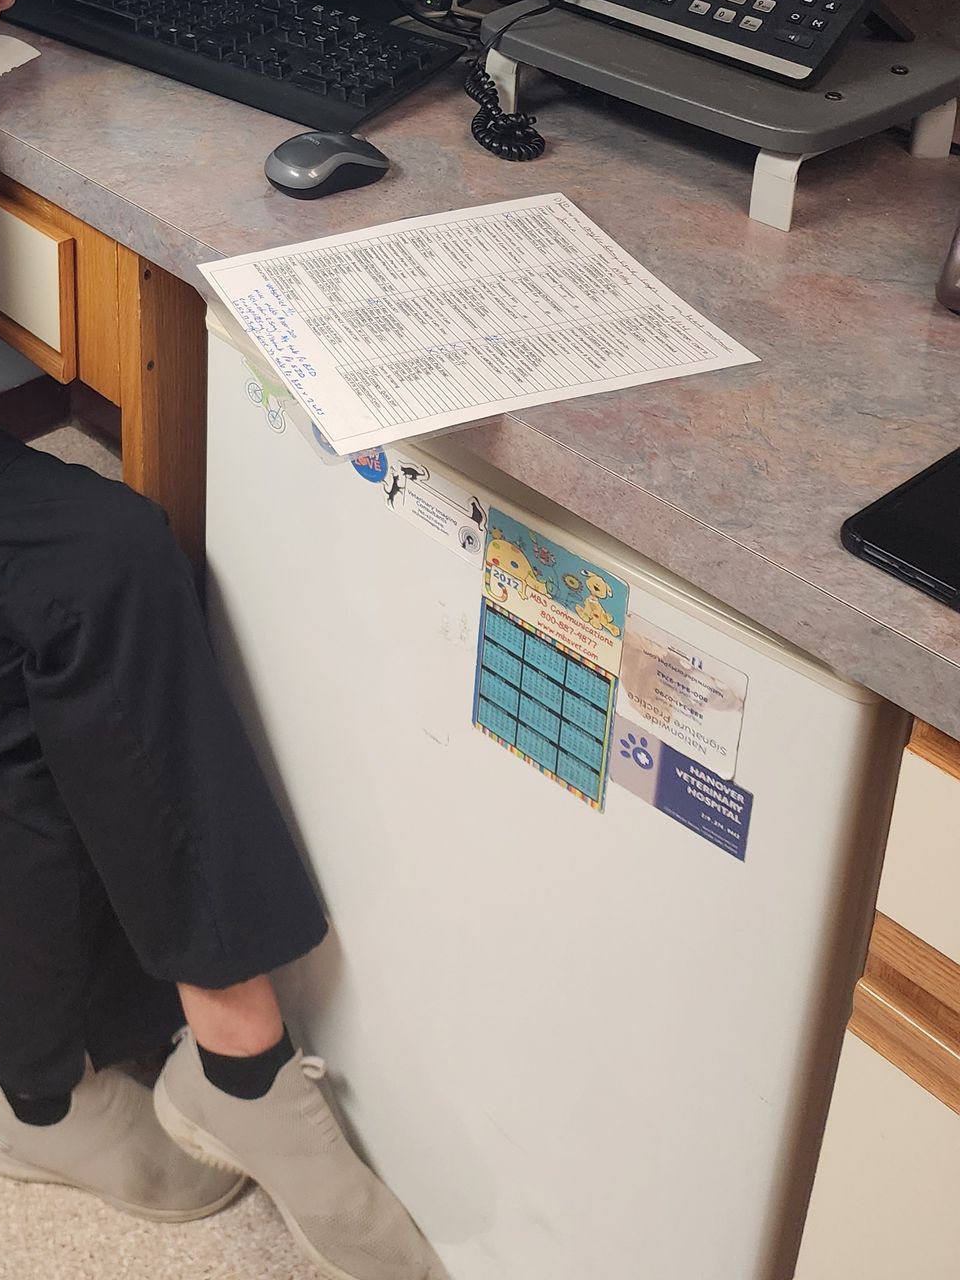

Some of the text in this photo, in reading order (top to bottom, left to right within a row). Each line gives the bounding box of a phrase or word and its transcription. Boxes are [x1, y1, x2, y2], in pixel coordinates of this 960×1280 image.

[407, 489, 435, 512] Veterinary
[493, 569, 519, 591] 2017
[529, 592, 614, 647] MBS Communications
[537, 620, 599, 661] www.mbsvet.com
[627, 691, 727, 756] Signature Practice
[645, 713, 707, 756] Nationwide
[675, 767, 743, 813] VETERINARY
[690, 765, 745, 804] HANOVER
[687, 786, 742, 825] HOSPITAL
